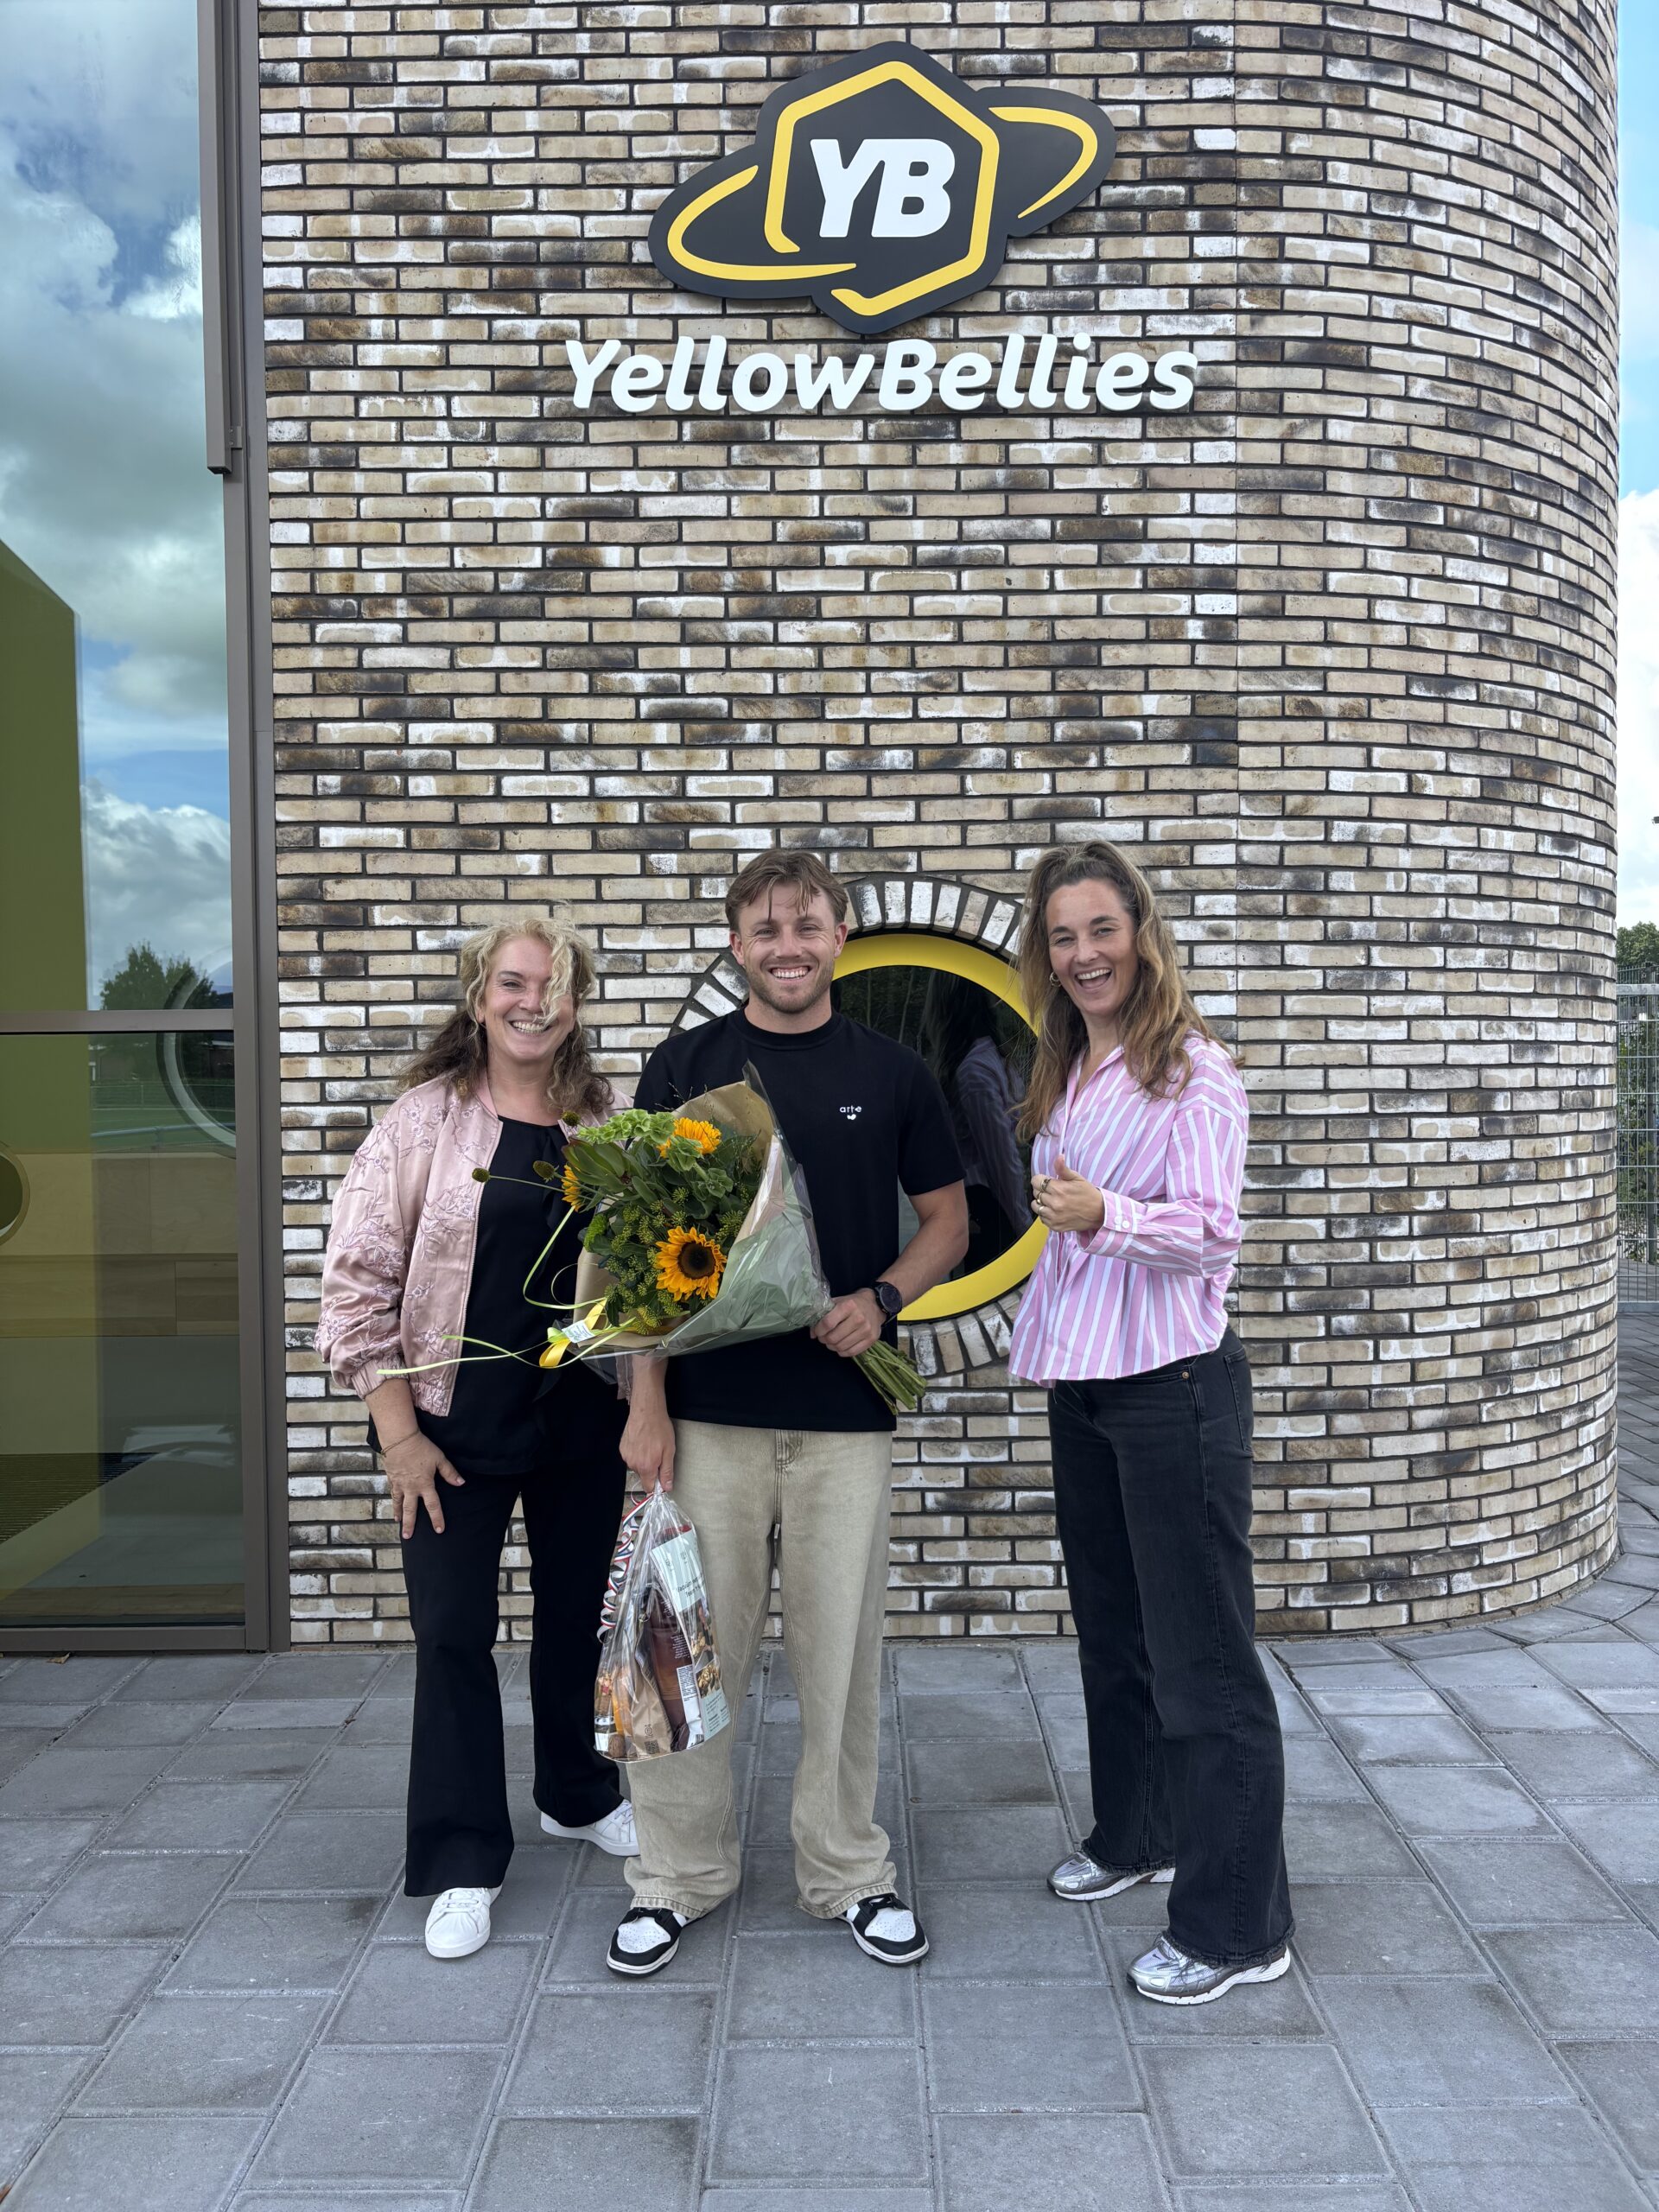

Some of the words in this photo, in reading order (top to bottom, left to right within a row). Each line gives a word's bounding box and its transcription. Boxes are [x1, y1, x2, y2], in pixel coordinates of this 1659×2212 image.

[810, 138, 956, 238] YB
[565, 333, 1199, 413] YellowBellies
[839, 1104, 862, 1114] arte
